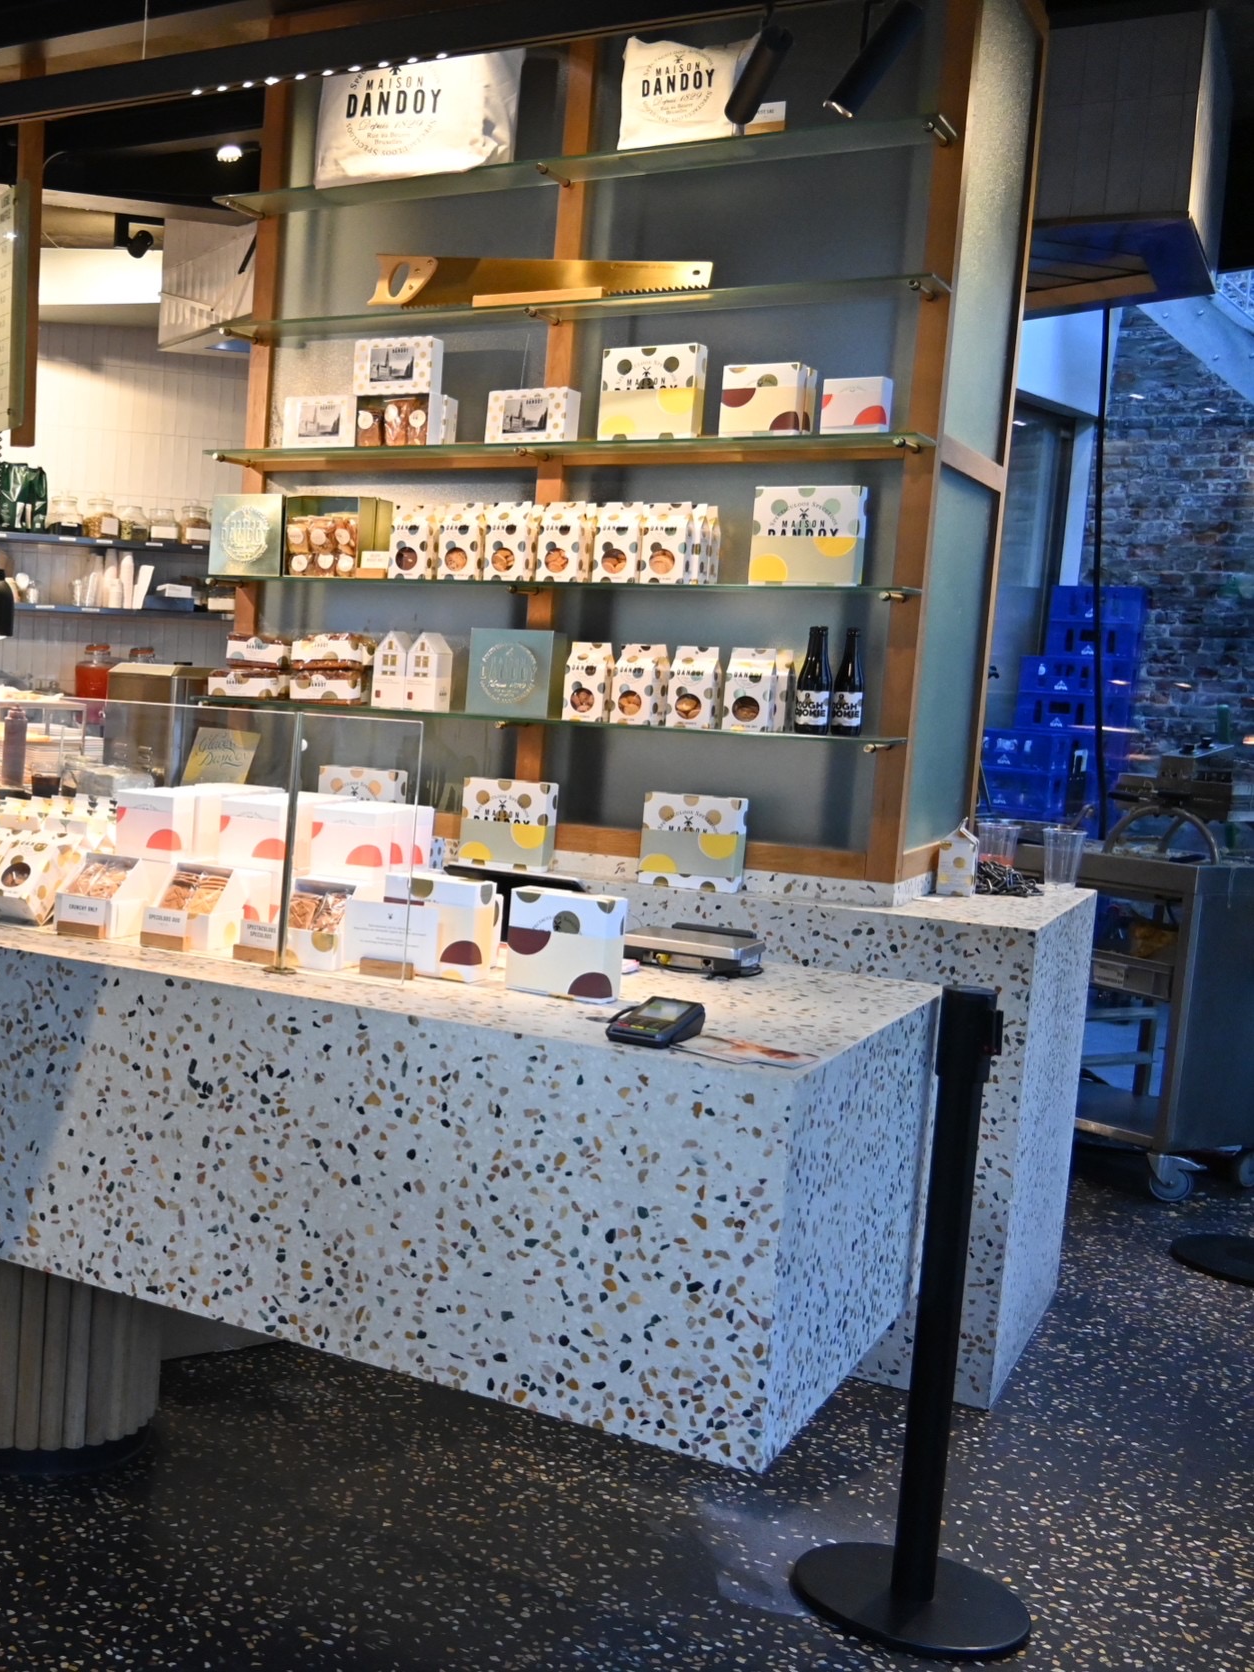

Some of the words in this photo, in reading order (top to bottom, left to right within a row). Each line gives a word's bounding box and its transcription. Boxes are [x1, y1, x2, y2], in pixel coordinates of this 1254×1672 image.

[655, 61, 701, 77] MAISON
[365, 75, 425, 91] MAISON
[641, 68, 715, 98] DANDOY
[345, 88, 443, 119] DANDOY
[626, 377, 666, 387] MAISON
[782, 519, 825, 529] MAISON
[485, 808, 520, 818] MAISON
